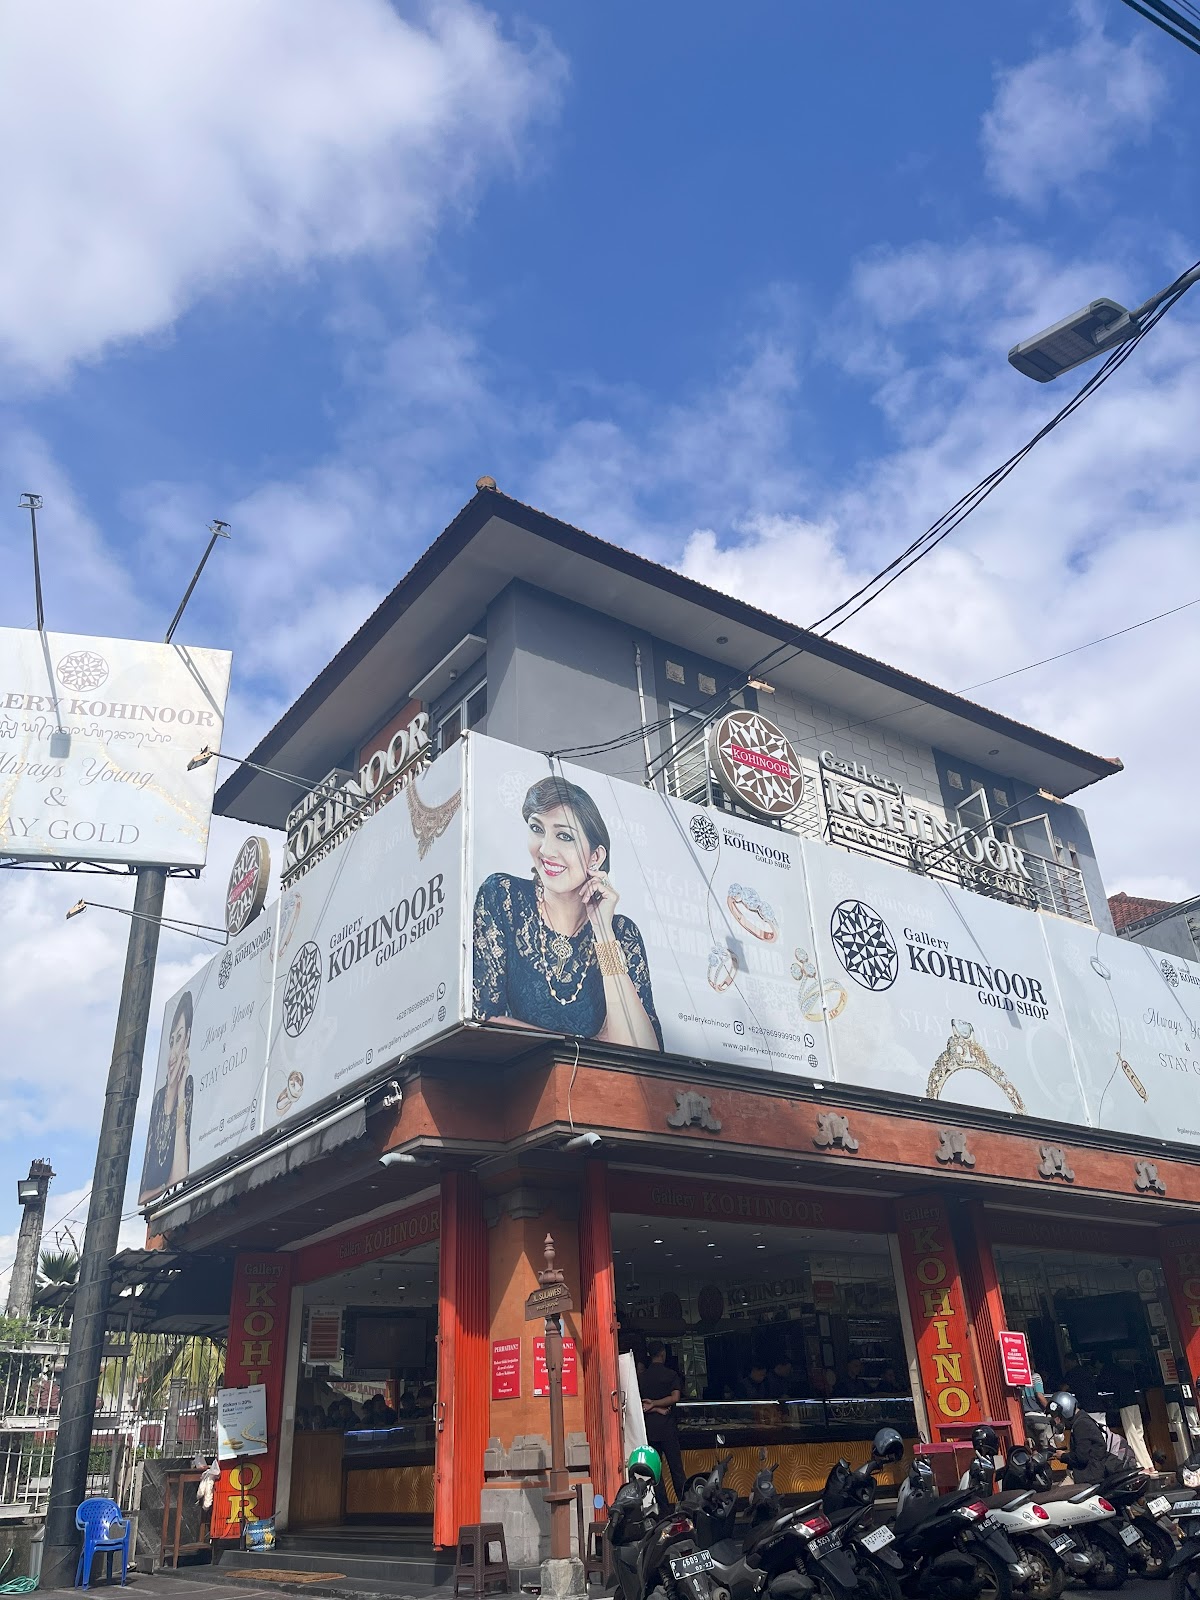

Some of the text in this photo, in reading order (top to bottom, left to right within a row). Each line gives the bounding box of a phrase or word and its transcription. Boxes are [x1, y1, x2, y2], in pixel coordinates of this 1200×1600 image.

[0, 692, 215, 727] ERY KOHINOOR
[79, 757, 154, 790] Young
[733, 748, 789, 775] KOHINOOR
[820, 750, 903, 802] Gallery
[44, 786, 68, 807] &
[280, 711, 433, 878] KOHINOOR
[285, 773, 338, 832] Gallery
[48, 819, 140, 844] GOLD
[825, 778, 1033, 881] KOHINOOR
[723, 834, 791, 865] KOHINOOR
[755, 854, 791, 871] GOLD SHOP
[327, 873, 445, 983] KOHINOOR
[330, 915, 363, 949] Gallery
[375, 906, 444, 967] GOLD SHOP
[903, 927, 949, 953] Gallery
[905, 943, 1048, 1006] KOHINOOR
[978, 991, 1049, 1021] GOLD SHOP
[1143, 1007, 1183, 1035] Always
[199, 1046, 248, 1092] STAY GOLD
[1158, 1052, 1188, 1073] STAY
[651, 1187, 824, 1223] Gallery KOHINOOR
[903, 1206, 942, 1223] Gallery
[364, 1210, 440, 1254] KOHINOOR
[244, 1262, 284, 1277] Gallery
